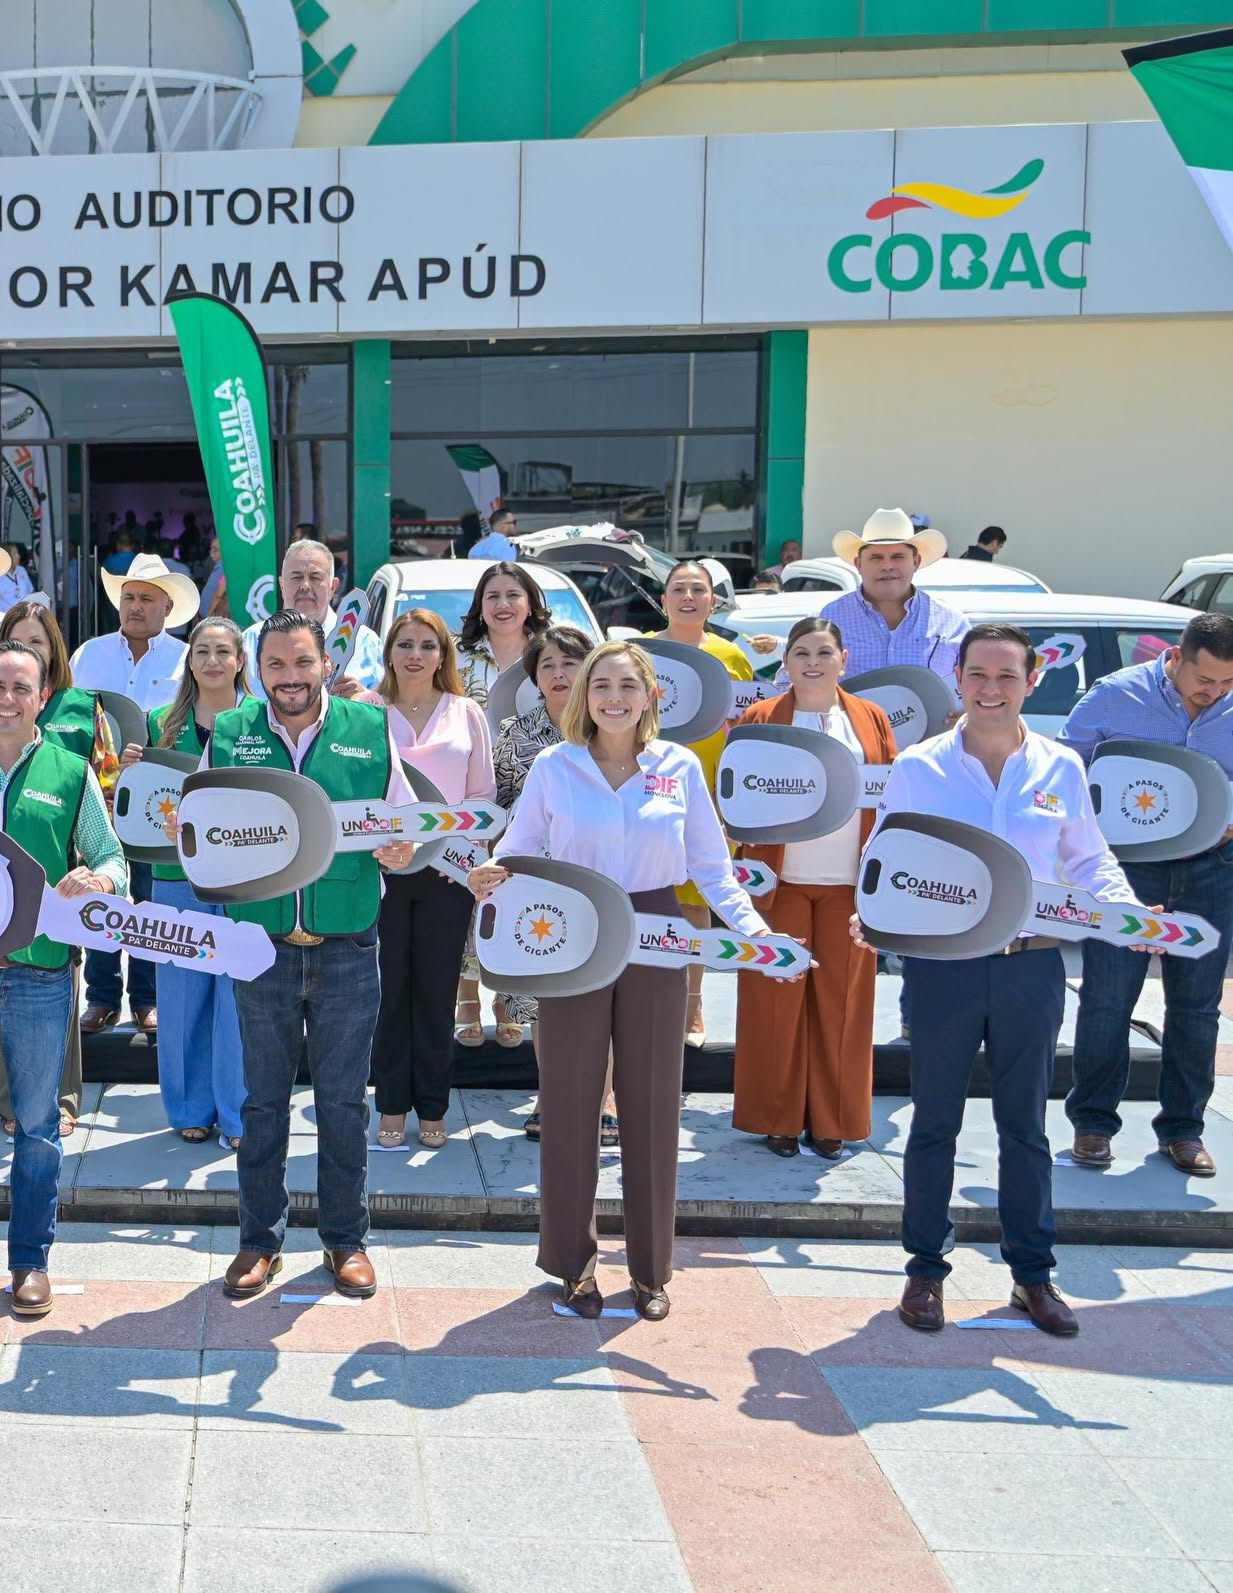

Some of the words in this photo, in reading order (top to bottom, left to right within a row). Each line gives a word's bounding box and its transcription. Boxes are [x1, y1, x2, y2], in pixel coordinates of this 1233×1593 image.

[74, 185, 355, 230] AUDITORIO
[827, 229, 1091, 293] COBAC
[118, 260, 347, 309] KAMAR
[368, 242, 547, 303] APÚD
[240, 404, 259, 459] DELANTE
[214, 377, 266, 545] COAHUILA
[659, 700, 678, 714] ANTE
[888, 706, 916, 722] UILA
[232, 746, 272, 757] MEJORA
[330, 743, 372, 757] COAHUILA
[645, 774, 679, 793] DIF
[742, 774, 816, 791] COAHUILA
[1135, 779, 1164, 791] PASOS
[23, 788, 63, 805] COAHUILA
[160, 787, 181, 797] PASO
[644, 789, 677, 801] MONCLOVA
[1120, 806, 1132, 818] DE
[1131, 808, 1169, 826] GIGANTE
[206, 825, 288, 845] COAHUILA
[247, 837, 275, 845] DELANTE
[890, 871, 977, 900] COAHUILA
[931, 892, 962, 904] DELANTE
[525, 906, 534, 915] A
[534, 903, 564, 918] PASOS
[78, 899, 217, 950] COAHUILA
[145, 937, 191, 956] DELANTE
[513, 932, 525, 946] DE
[524, 936, 568, 956] GIGANTE
